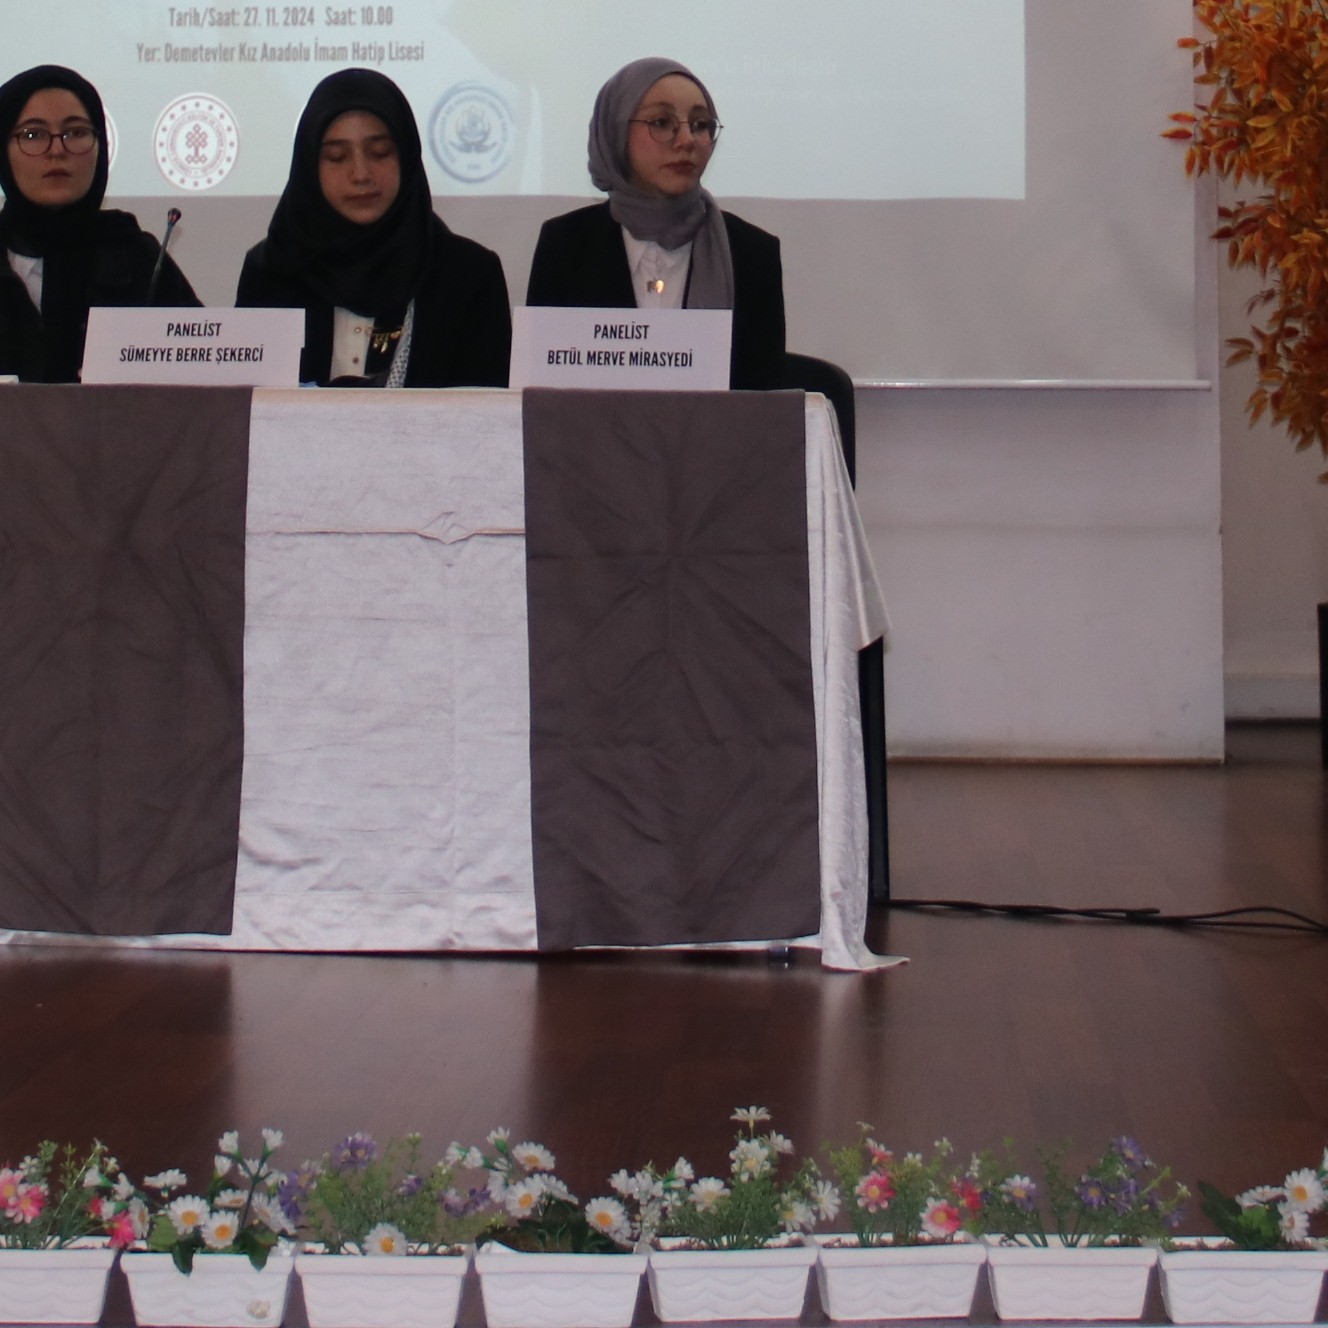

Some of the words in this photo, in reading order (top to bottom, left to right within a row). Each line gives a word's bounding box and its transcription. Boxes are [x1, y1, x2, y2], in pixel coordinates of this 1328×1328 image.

[243, 6, 262, 26] 27.
[283, 6, 315, 26] 2024
[325, 5, 356, 26] Saat:
[361, 5, 394, 26] 10.00
[164, 42, 235, 62] Demetevler
[238, 42, 257, 62] Kız
[260, 42, 311, 62] Anadolu
[314, 36, 348, 61] İmam
[352, 40, 385, 66] Hatip
[388, 40, 425, 61] Lisesi
[166, 320, 222, 337] PANELİST
[593, 321, 649, 340] PANELİST
[119, 344, 173, 362] SÜMEYYE
[175, 347, 212, 362] BERRE
[215, 344, 264, 364] ŞEKERCİ
[547, 347, 583, 365] BETÜL
[586, 350, 625, 366] MERVE
[628, 348, 693, 367] MİRASYEDİ
